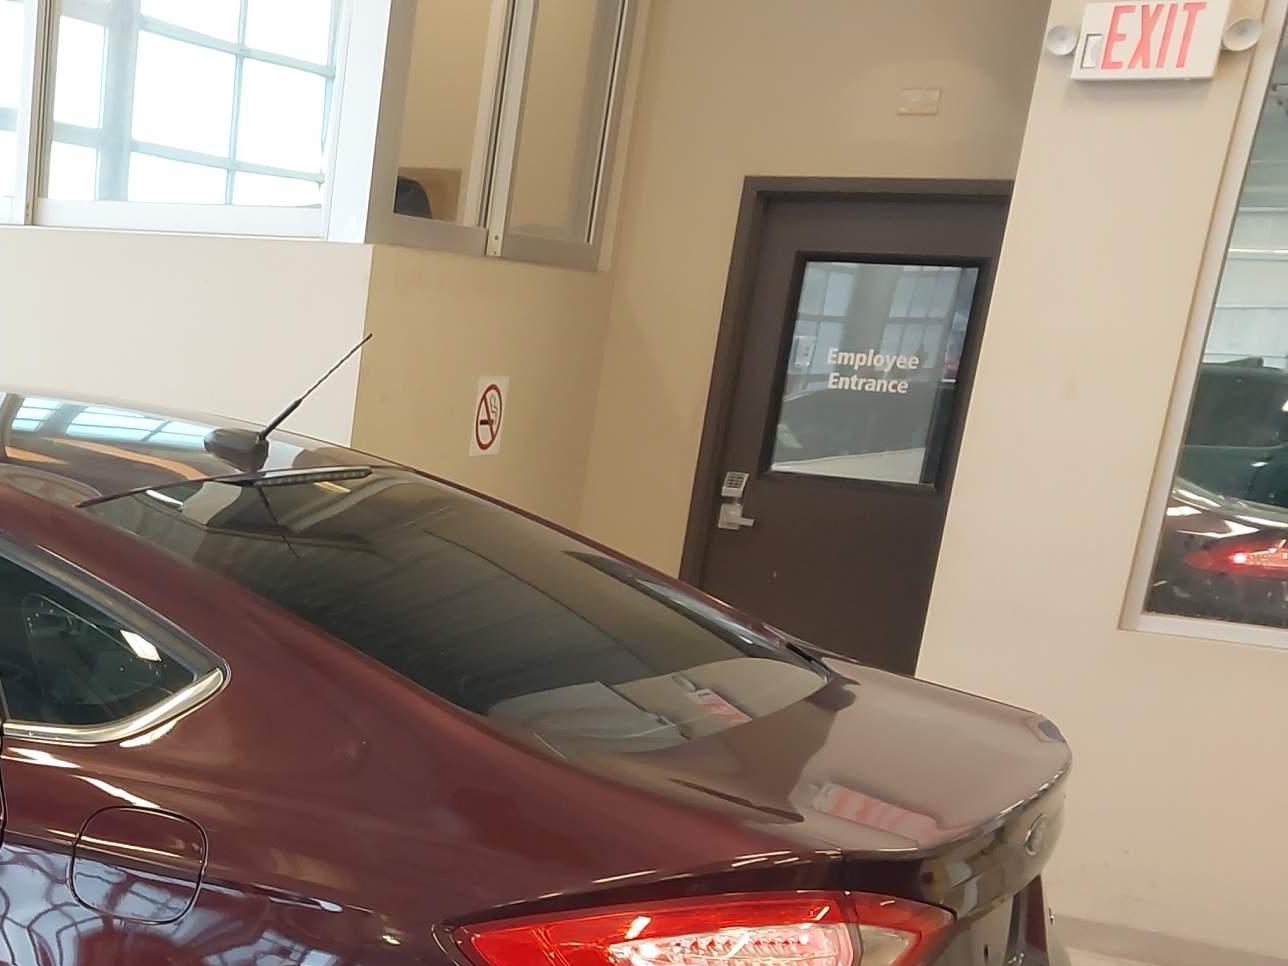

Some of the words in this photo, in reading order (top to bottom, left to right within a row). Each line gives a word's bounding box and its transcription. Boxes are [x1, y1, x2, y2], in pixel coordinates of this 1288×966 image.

[1101, 3, 1207, 69] EXIT
[827, 347, 920, 372] Employee
[827, 372, 909, 394] Entrance
